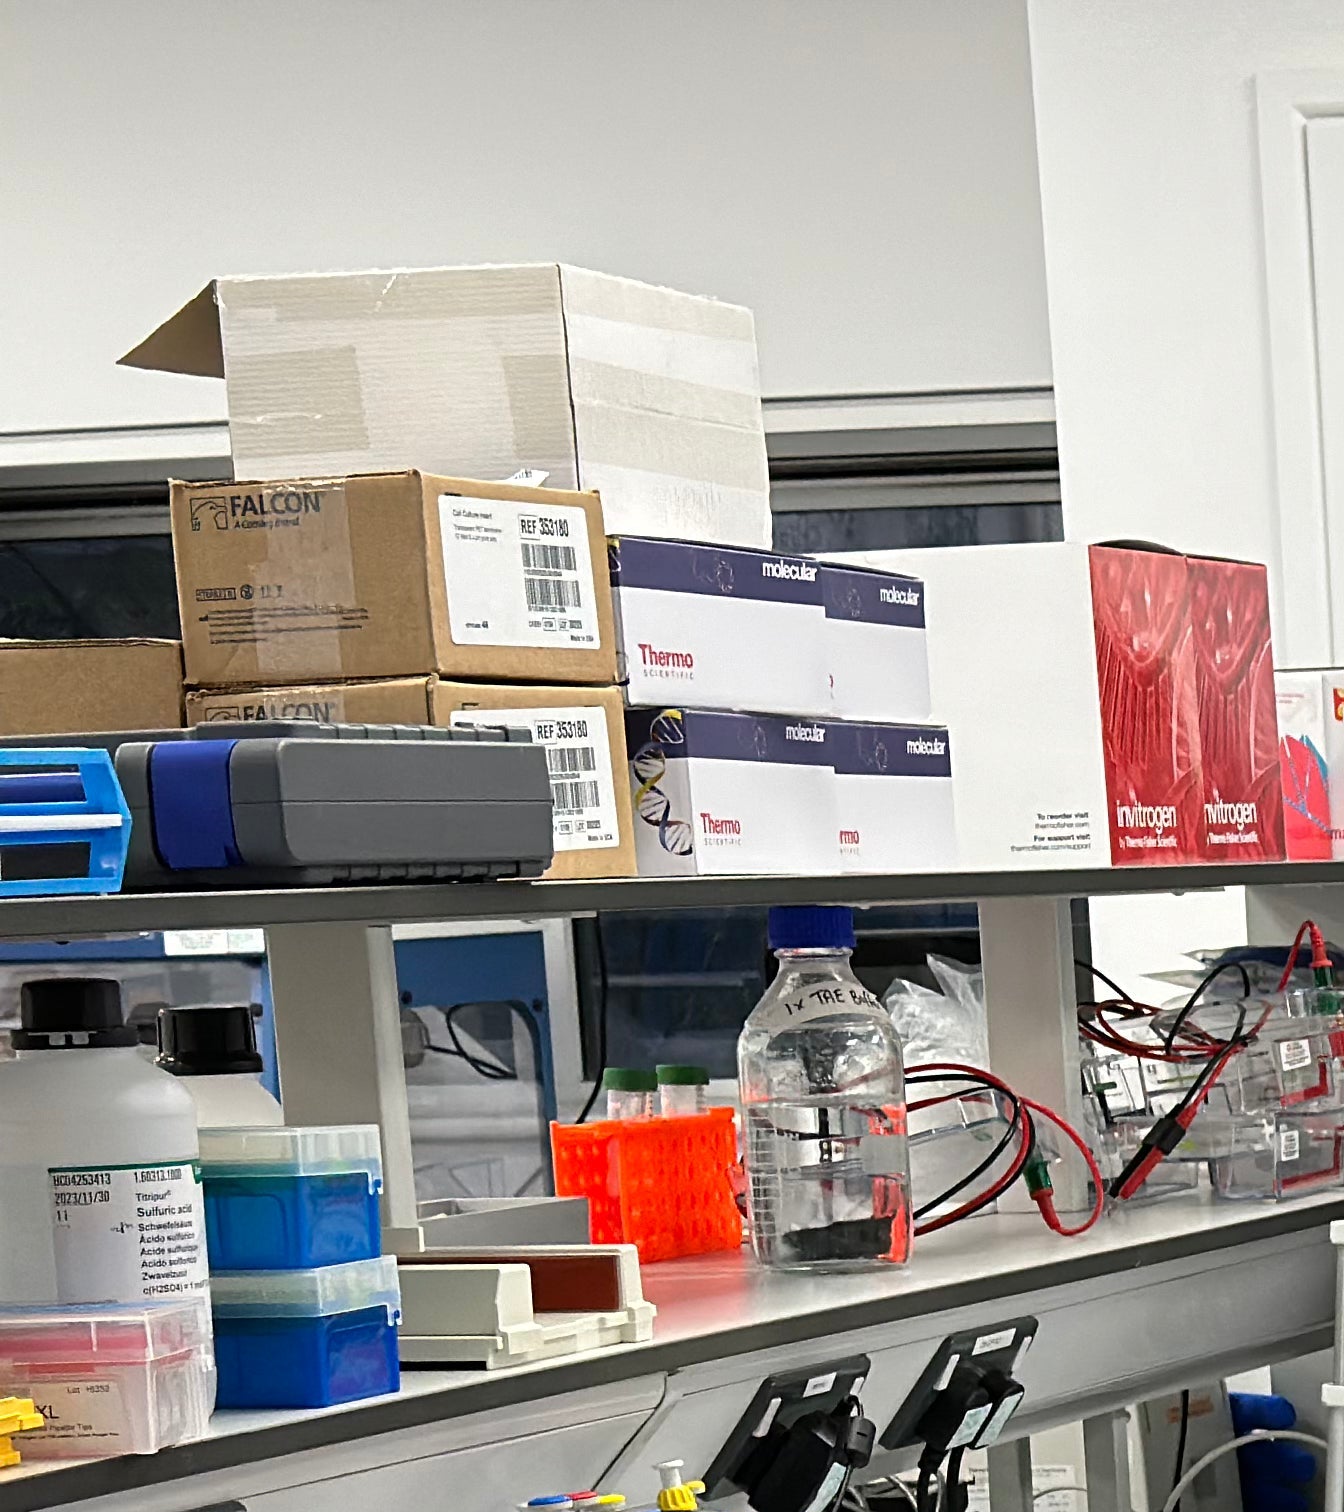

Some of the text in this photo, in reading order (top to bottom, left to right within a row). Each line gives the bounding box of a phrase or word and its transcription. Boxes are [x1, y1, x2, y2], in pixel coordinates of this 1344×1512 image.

[231, 491, 321, 517] FALCON
[520, 518, 537, 534] REF
[539, 517, 569, 538] 353180
[762, 560, 817, 582] molecular
[880, 586, 920, 607] molecular
[638, 643, 693, 669] Thermo
[643, 669, 694, 680] SCIENTIFIC
[243, 702, 330, 723] FALCON
[537, 720, 588, 740] REF 353180
[785, 723, 826, 743] molecular
[907, 736, 946, 756] molecular
[700, 813, 741, 836] Thermo
[1117, 799, 1178, 835] invitrogen
[1203, 799, 1258, 832] nvitrogen
[839, 829, 860, 845] rmo
[809, 988, 846, 1005] TAE
[54, 1190, 110, 1206] 2023/11/30
[137, 1203, 193, 1218] Sulfuric acid
